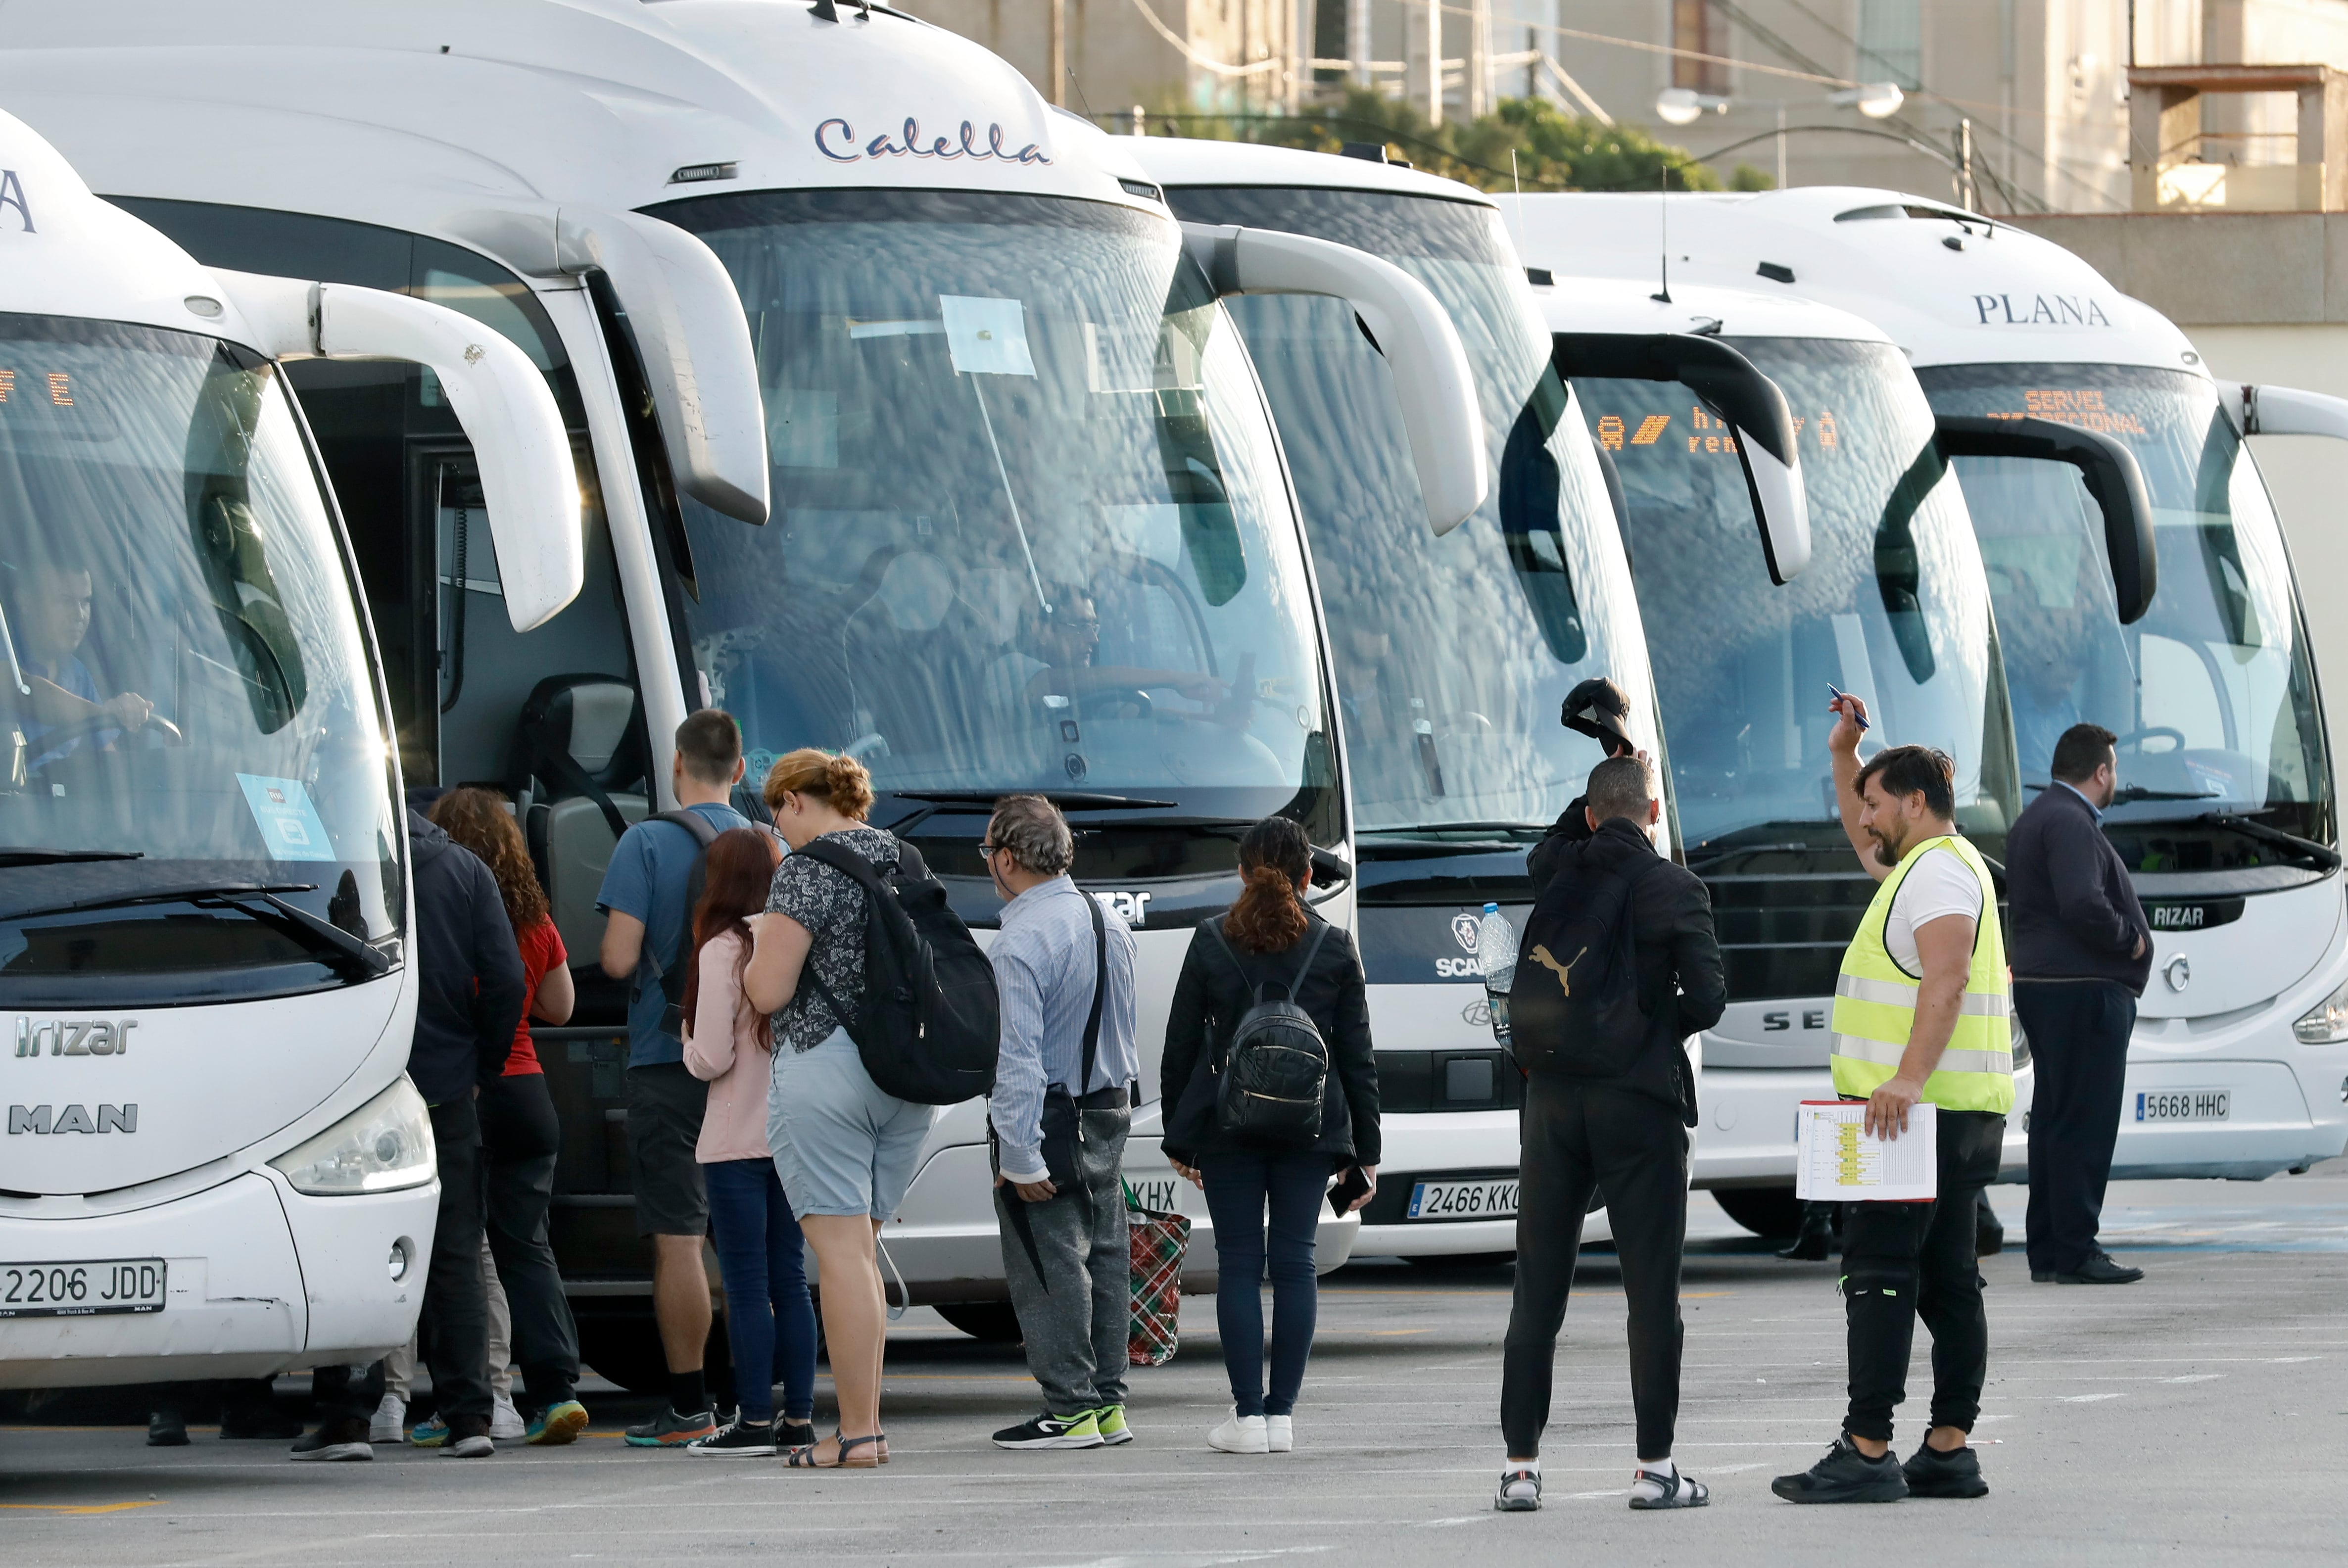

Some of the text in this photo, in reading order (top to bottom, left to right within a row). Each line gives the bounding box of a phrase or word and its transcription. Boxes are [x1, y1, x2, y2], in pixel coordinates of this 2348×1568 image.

[815, 117, 1053, 165] Calella
[1970, 293, 2111, 327] PLANA
[2025, 390, 2106, 411] SERVEI
[9, 1104, 138, 1134] MAN
[2148, 1094, 2226, 1117] 5668 HHC
[1133, 1181, 1176, 1211] KHX
[1427, 1187, 1483, 1213] 2466
[5, 1266, 155, 1302] 2206 JDD
